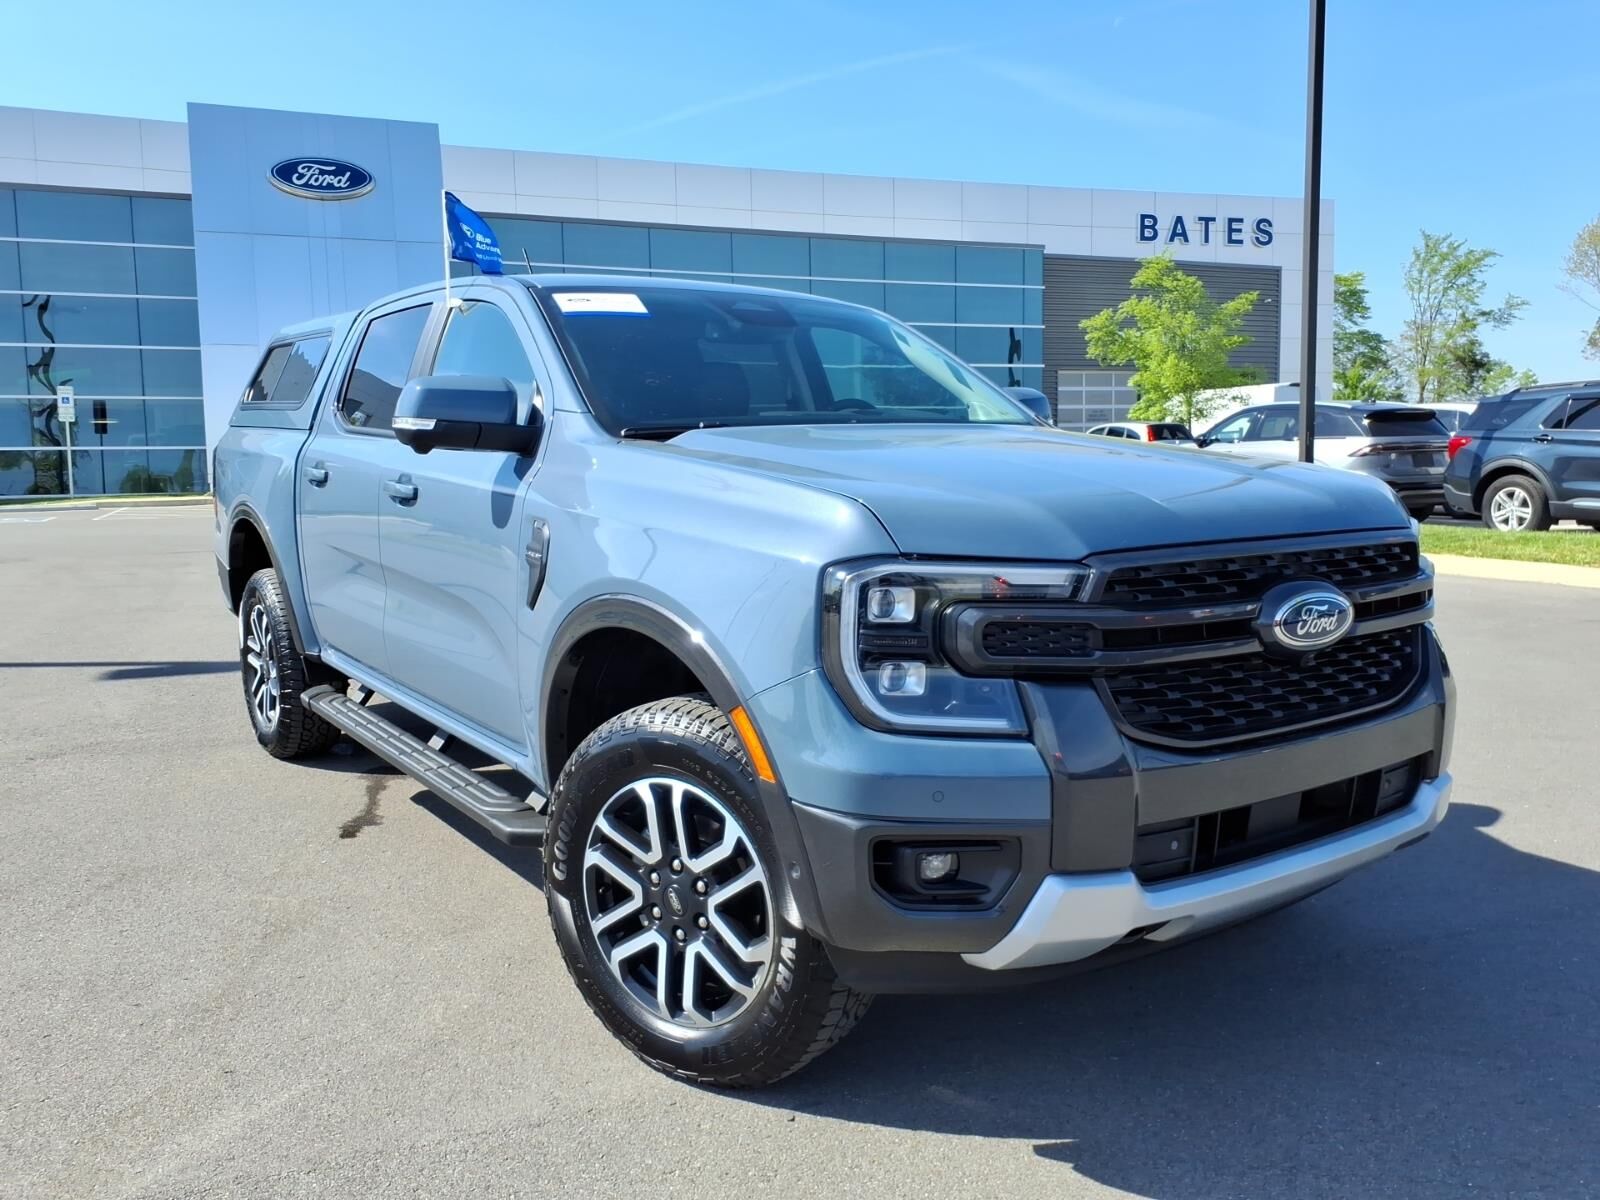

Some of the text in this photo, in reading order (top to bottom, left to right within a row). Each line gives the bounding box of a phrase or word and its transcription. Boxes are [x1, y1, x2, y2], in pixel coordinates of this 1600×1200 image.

[292, 163, 351, 188] Ford
[1139, 213, 1273, 247] BATES
[1296, 604, 1338, 635] Ford
